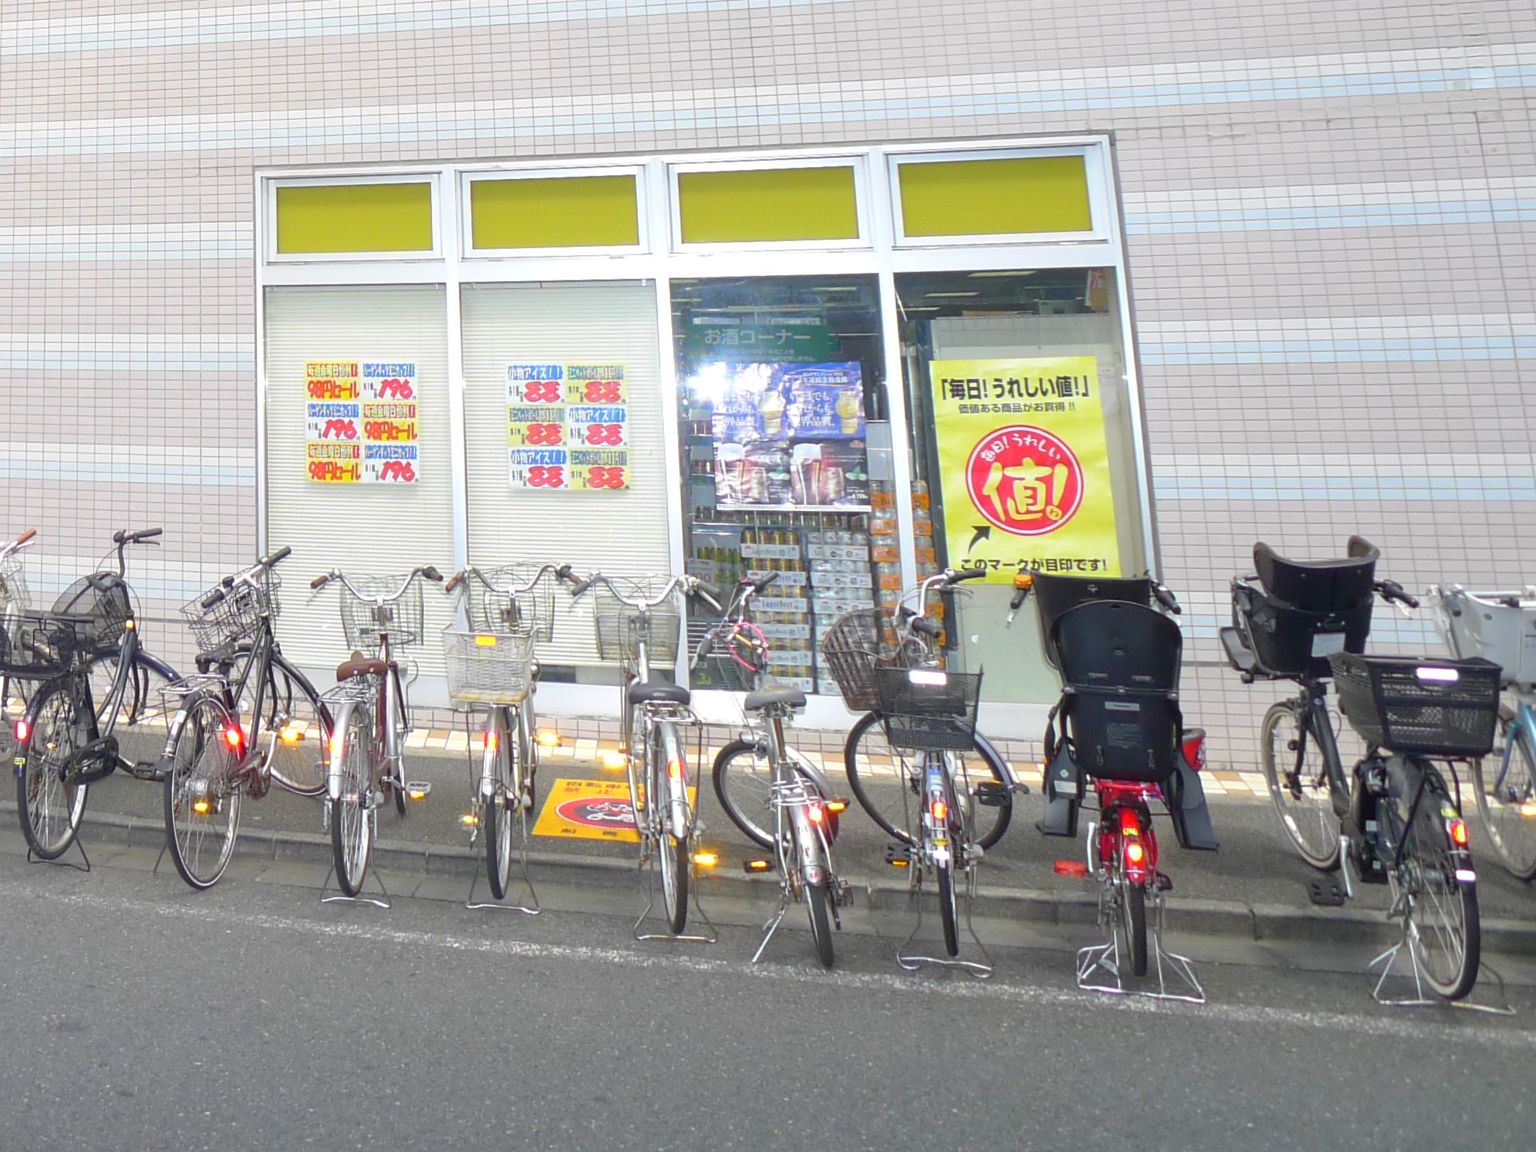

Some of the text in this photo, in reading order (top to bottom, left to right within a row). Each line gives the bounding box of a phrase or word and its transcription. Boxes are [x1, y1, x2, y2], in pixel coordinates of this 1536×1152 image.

[704, 328, 811, 346] お酒コーナー
